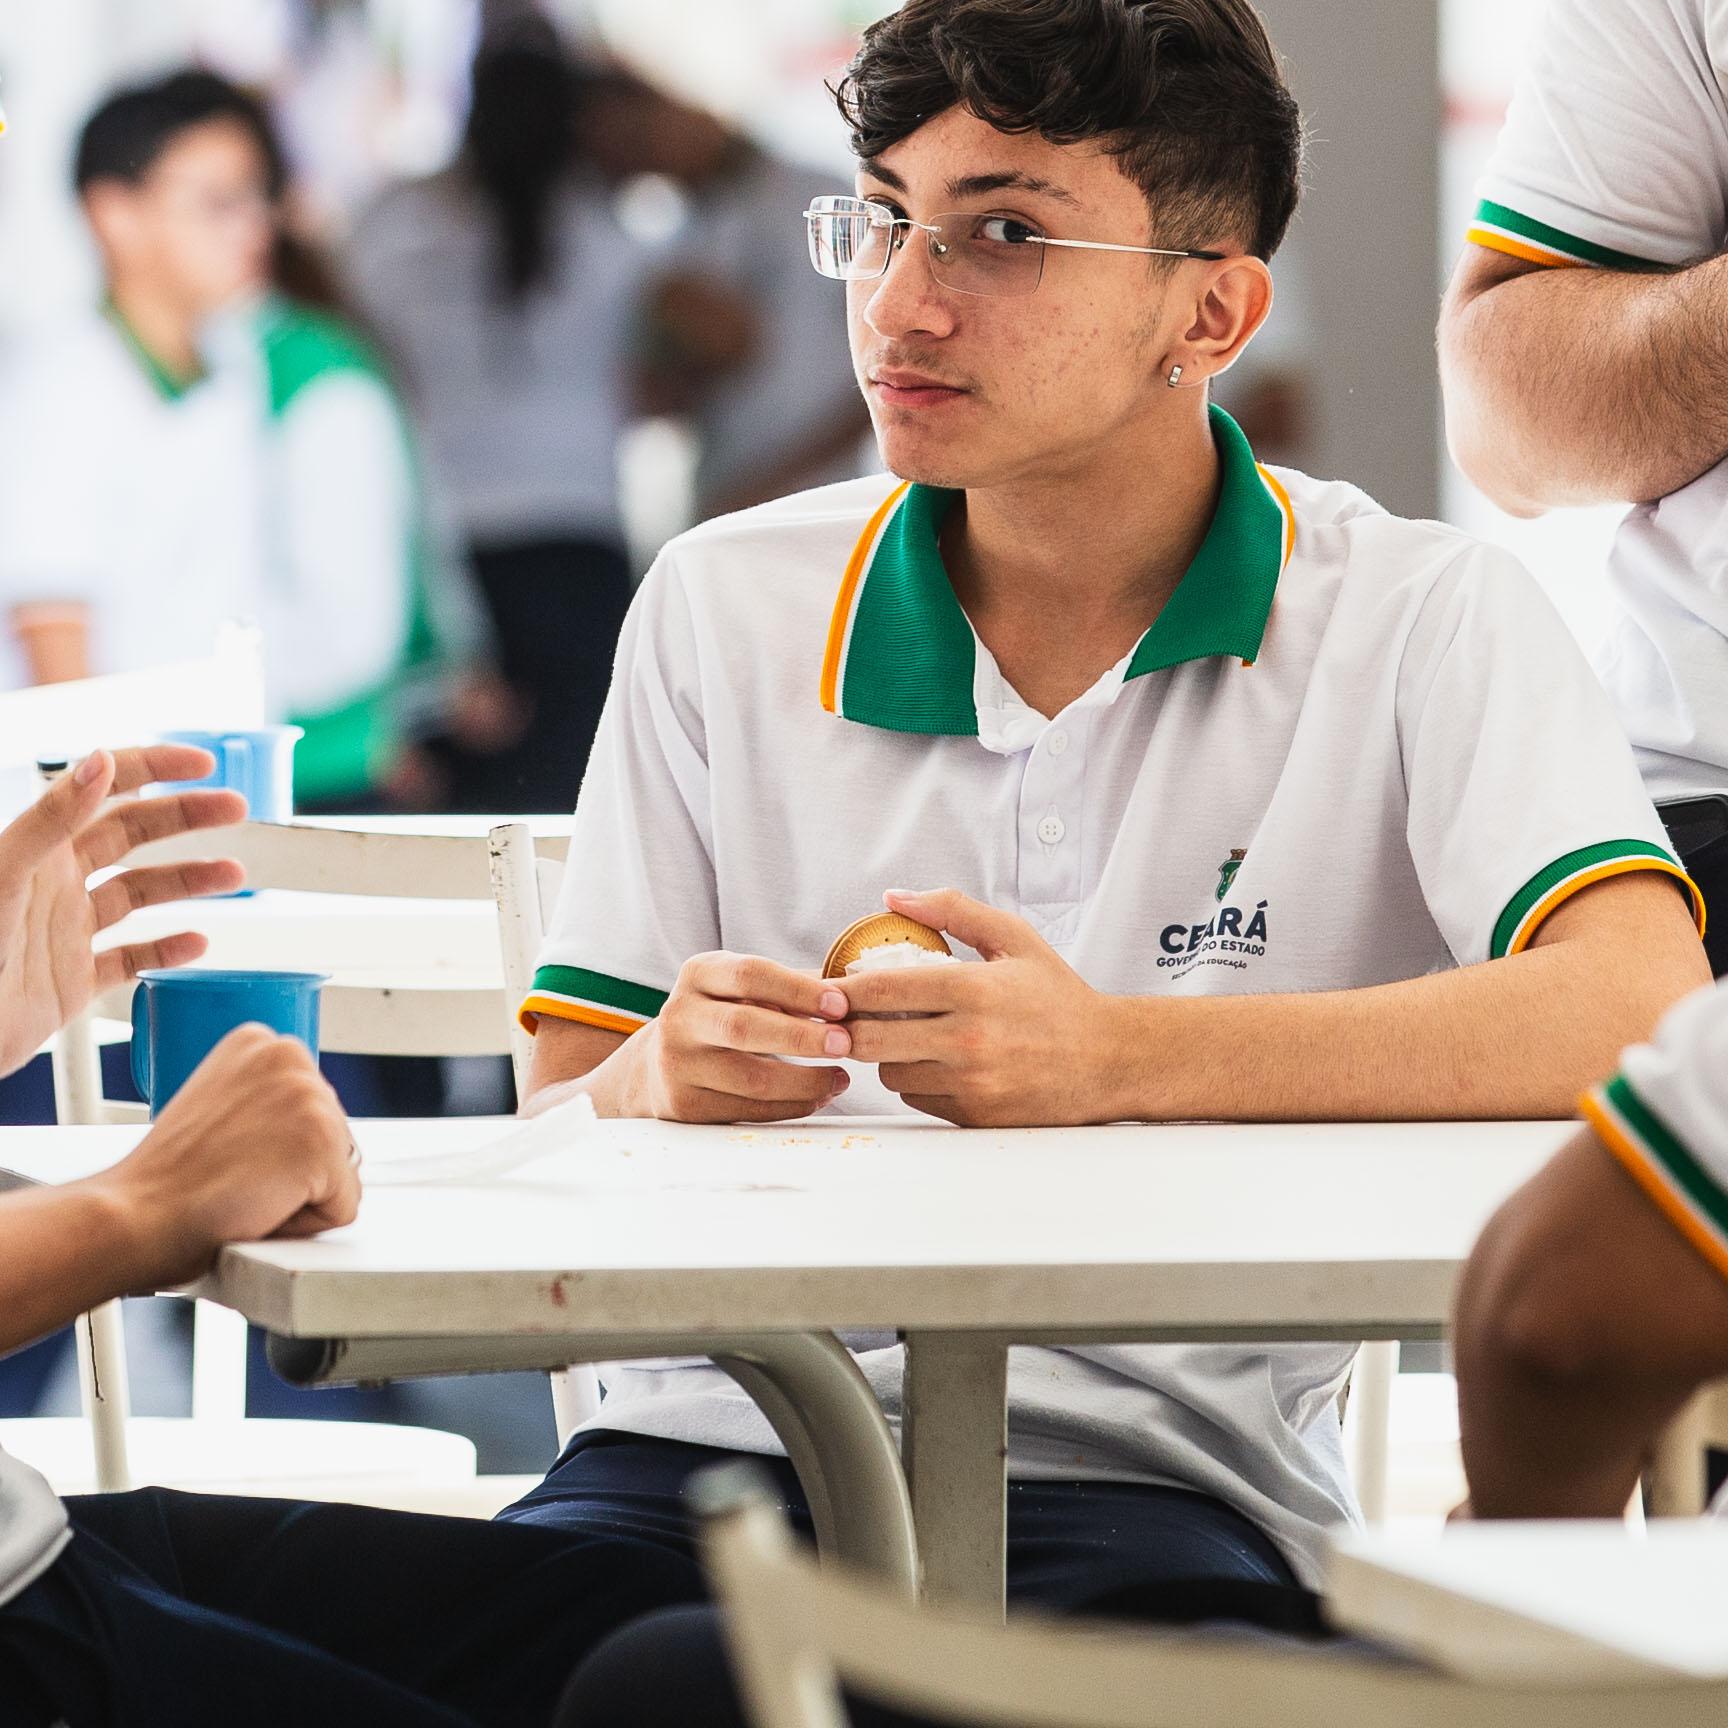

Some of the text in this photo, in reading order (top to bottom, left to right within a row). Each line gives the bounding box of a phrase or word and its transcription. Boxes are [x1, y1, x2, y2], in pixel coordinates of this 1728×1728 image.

[1160, 900, 1268, 954] CEARÁ
[1202, 941, 1217, 952] DO
[1221, 940, 1265, 956] ESTADO
[1207, 959, 1247, 969] EDUCAÇÃO
